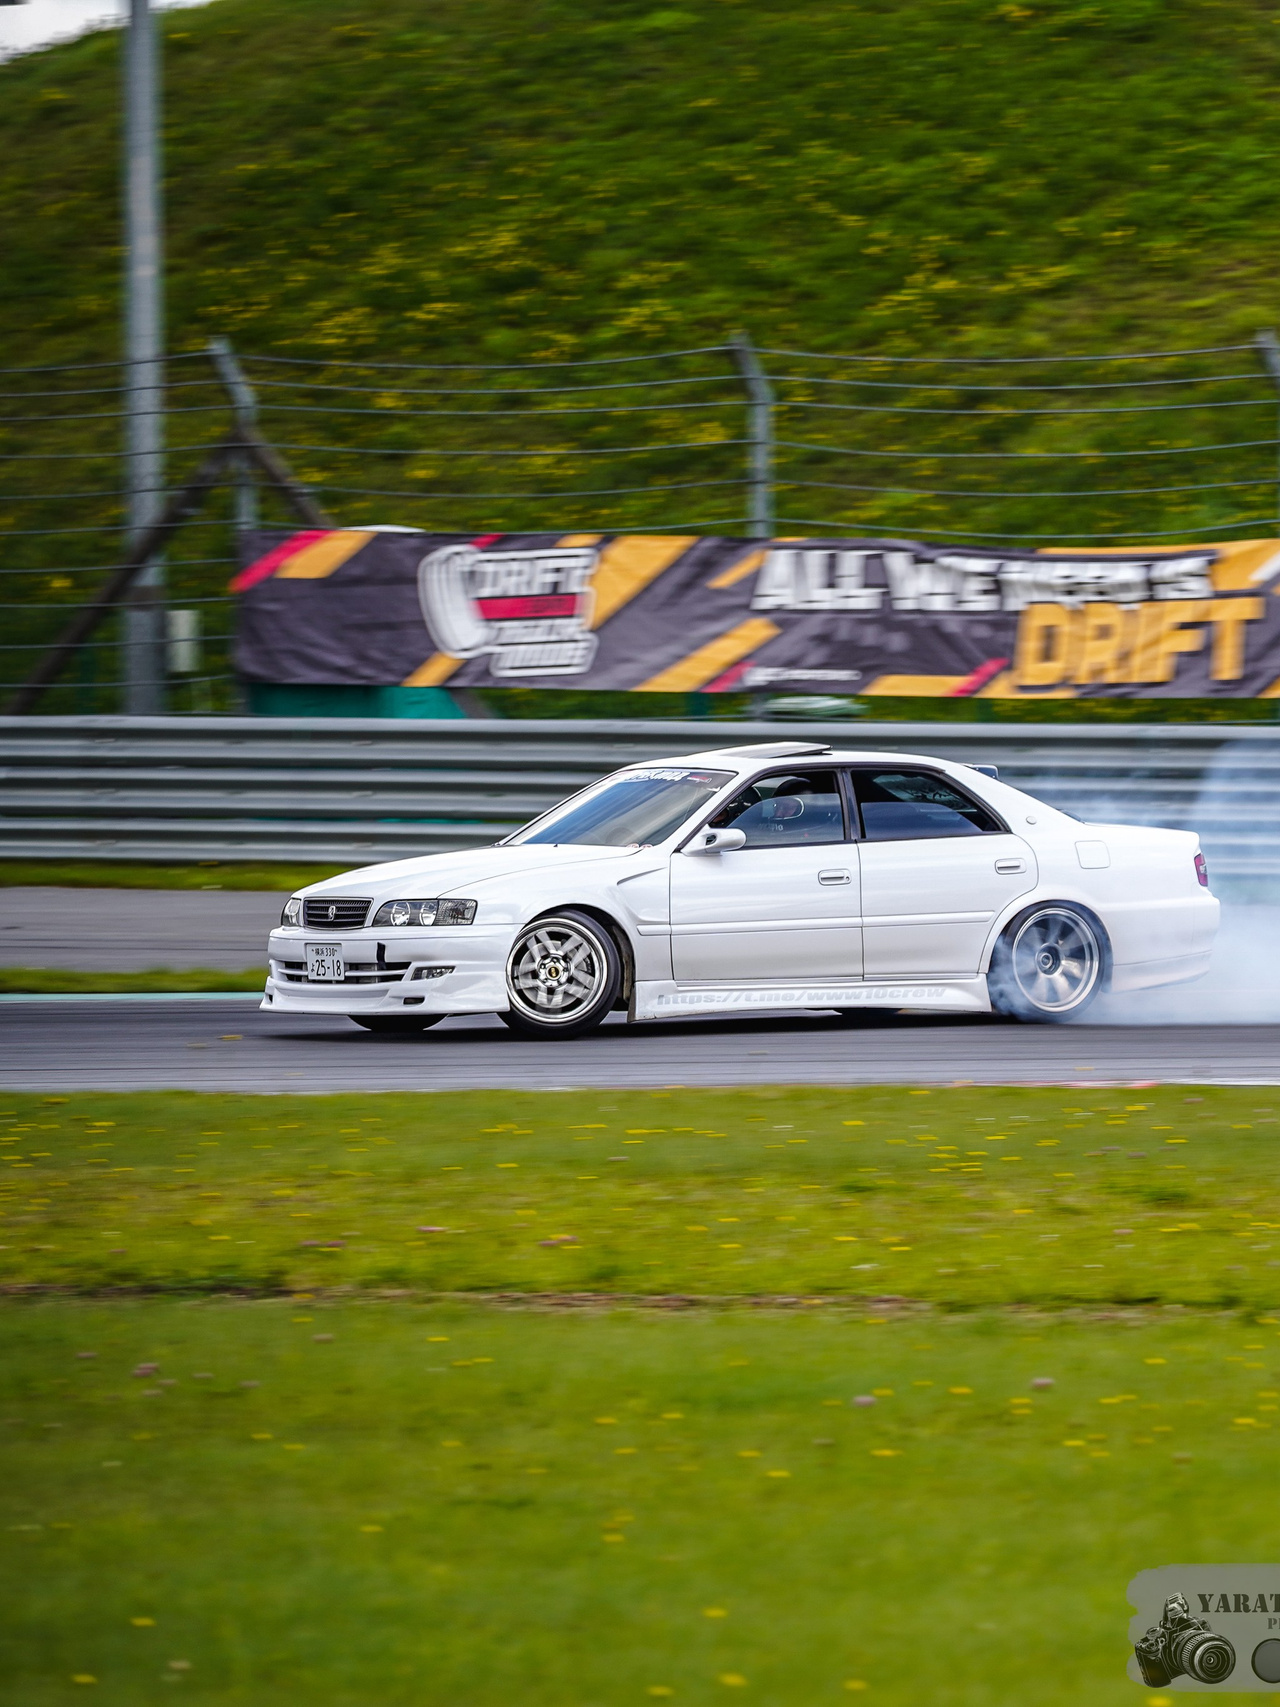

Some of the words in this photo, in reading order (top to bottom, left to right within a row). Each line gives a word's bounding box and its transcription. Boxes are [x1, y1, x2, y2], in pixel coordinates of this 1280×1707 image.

[750, 550, 888, 611] ALL
[884, 551, 1001, 612] WE
[1016, 597, 1266, 686] DRIFT
[315, 959, 342, 977] 25-18
[656, 987, 947, 1007] https://t.me/www10crew
